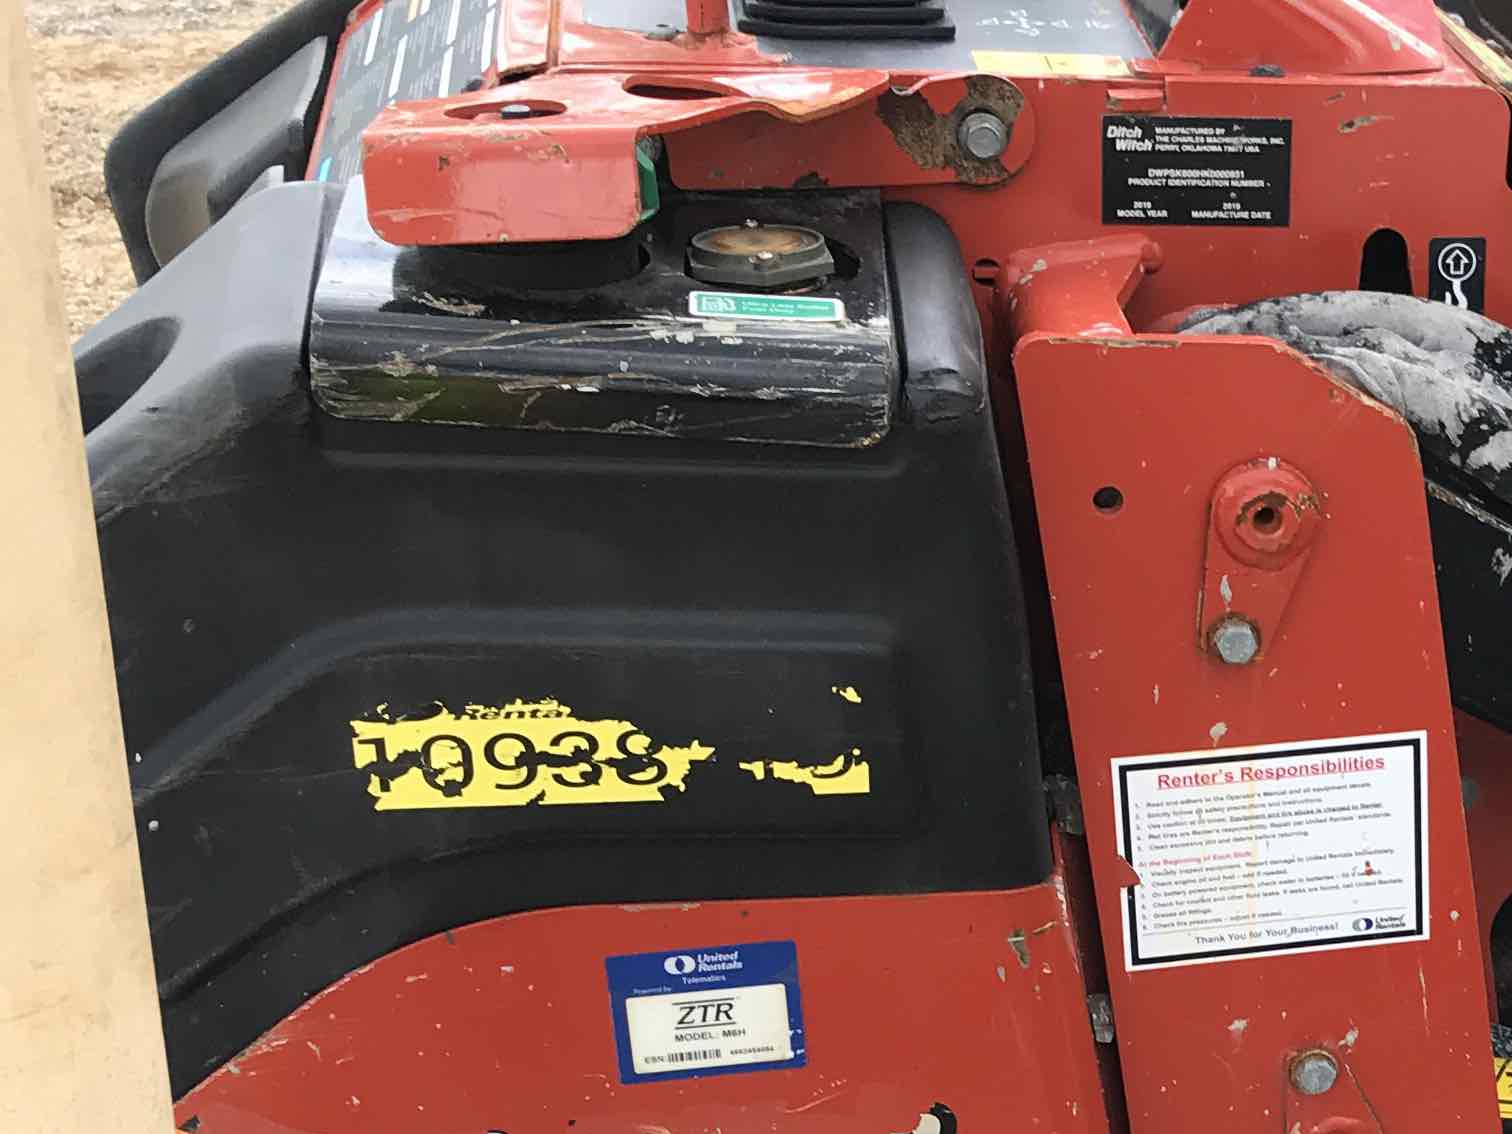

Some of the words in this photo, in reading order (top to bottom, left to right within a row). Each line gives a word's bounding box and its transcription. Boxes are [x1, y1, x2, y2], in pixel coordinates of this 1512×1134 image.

[1107, 125, 1142, 138] Ditch
[1155, 127, 1213, 135] MANUFACTURED
[1115, 138, 1152, 151] Witch
[1181, 145, 1223, 153] OKLAHOMA
[1128, 178, 1166, 186] PRODUCT
[1168, 179, 1229, 187] IDENTIFICATION
[1231, 180, 1265, 188] NUMBER
[1117, 209, 1145, 217] MODEL
[1146, 210, 1168, 218] YEAR
[1192, 210, 1249, 219] MANUFACTURE
[1250, 211, 1272, 219] DATE
[1157, 768, 1234, 789] Renter's
[1239, 754, 1385, 782] Responsibilities
[1312, 783, 1347, 793] equipment
[1305, 816, 1327, 826] United
[1162, 855, 1200, 866] Beginning
[1374, 912, 1406, 924] United
[1375, 919, 1406, 931] Rentals
[1194, 931, 1225, 944] Thank
[1227, 929, 1246, 941] You
[1248, 928, 1262, 939] for
[1264, 925, 1289, 937] Your
[1289, 920, 1339, 934] Business!
[697, 951, 738, 963] United
[698, 961, 743, 973] Rentals
[682, 974, 726, 985] Telematics
[677, 1002, 735, 1025] ZTR
[674, 1030, 719, 1043] MODEL:
